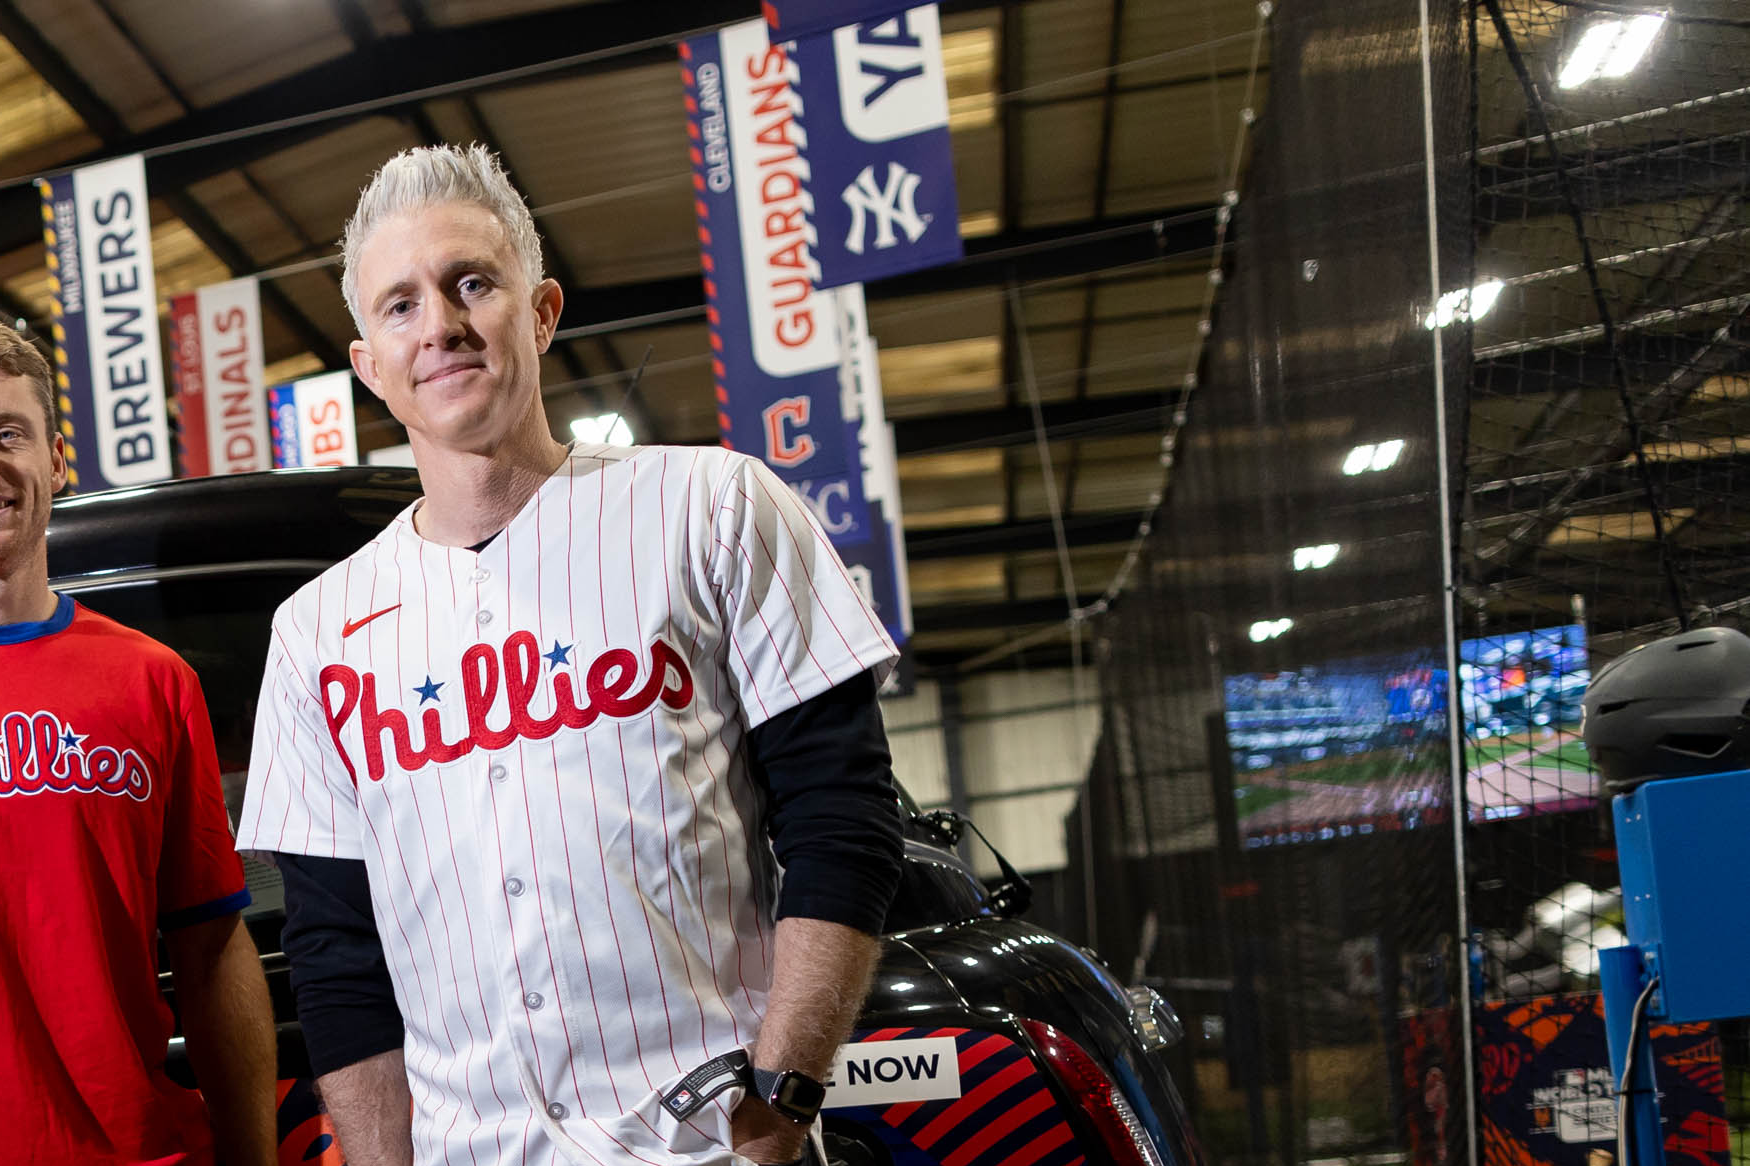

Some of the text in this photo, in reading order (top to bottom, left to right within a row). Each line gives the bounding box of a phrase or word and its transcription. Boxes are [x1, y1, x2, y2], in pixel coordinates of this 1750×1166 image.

[708, 62, 731, 193] CLEVELAND
[53, 199, 84, 313] MILWAUKEE
[748, 44, 813, 349] GUARDIANS
[94, 189, 157, 468] BREWERS
[310, 400, 345, 467] BS
[319, 630, 695, 791] Phillies
[847, 1053, 940, 1086] NOW
